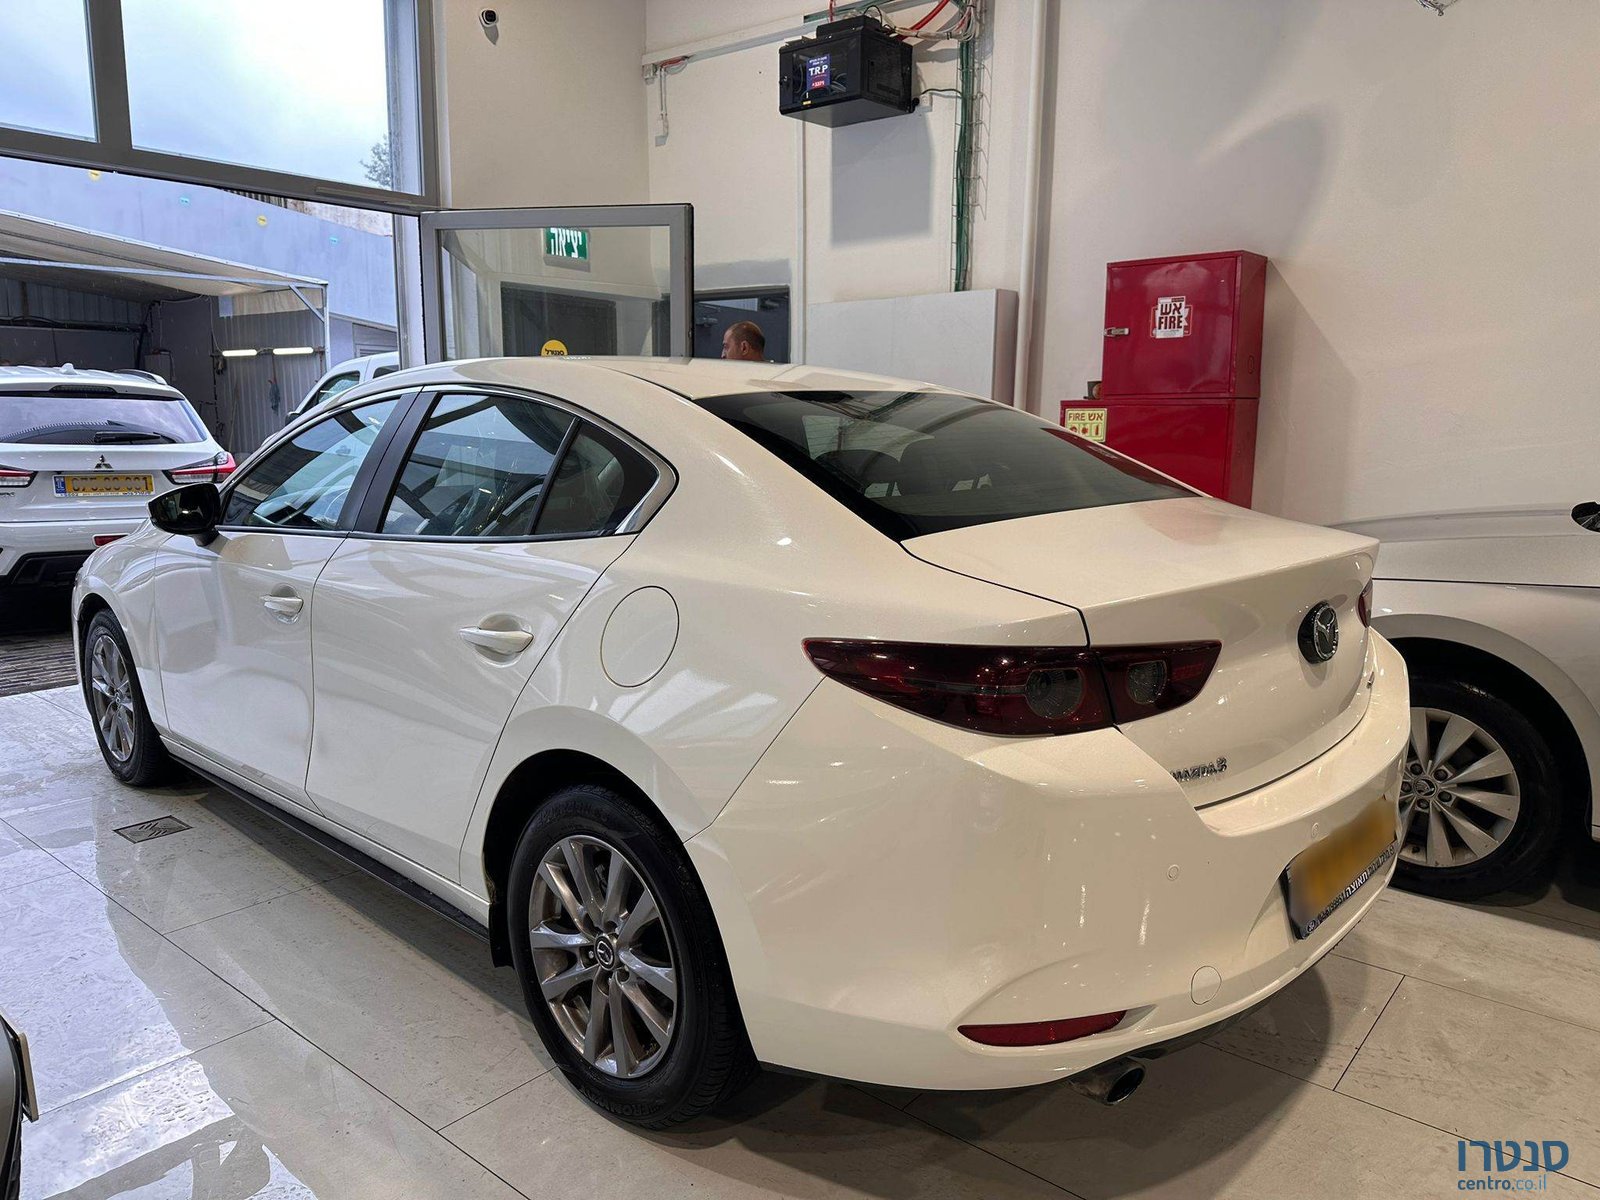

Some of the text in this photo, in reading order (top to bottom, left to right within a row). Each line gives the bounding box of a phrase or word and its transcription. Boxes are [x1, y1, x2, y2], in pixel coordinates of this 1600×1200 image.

[550, 227, 582, 258] יציאה
[1160, 302, 1182, 316] אש
[1158, 315, 1183, 330] FIRE
[1068, 412, 1104, 421] FIRE אש
